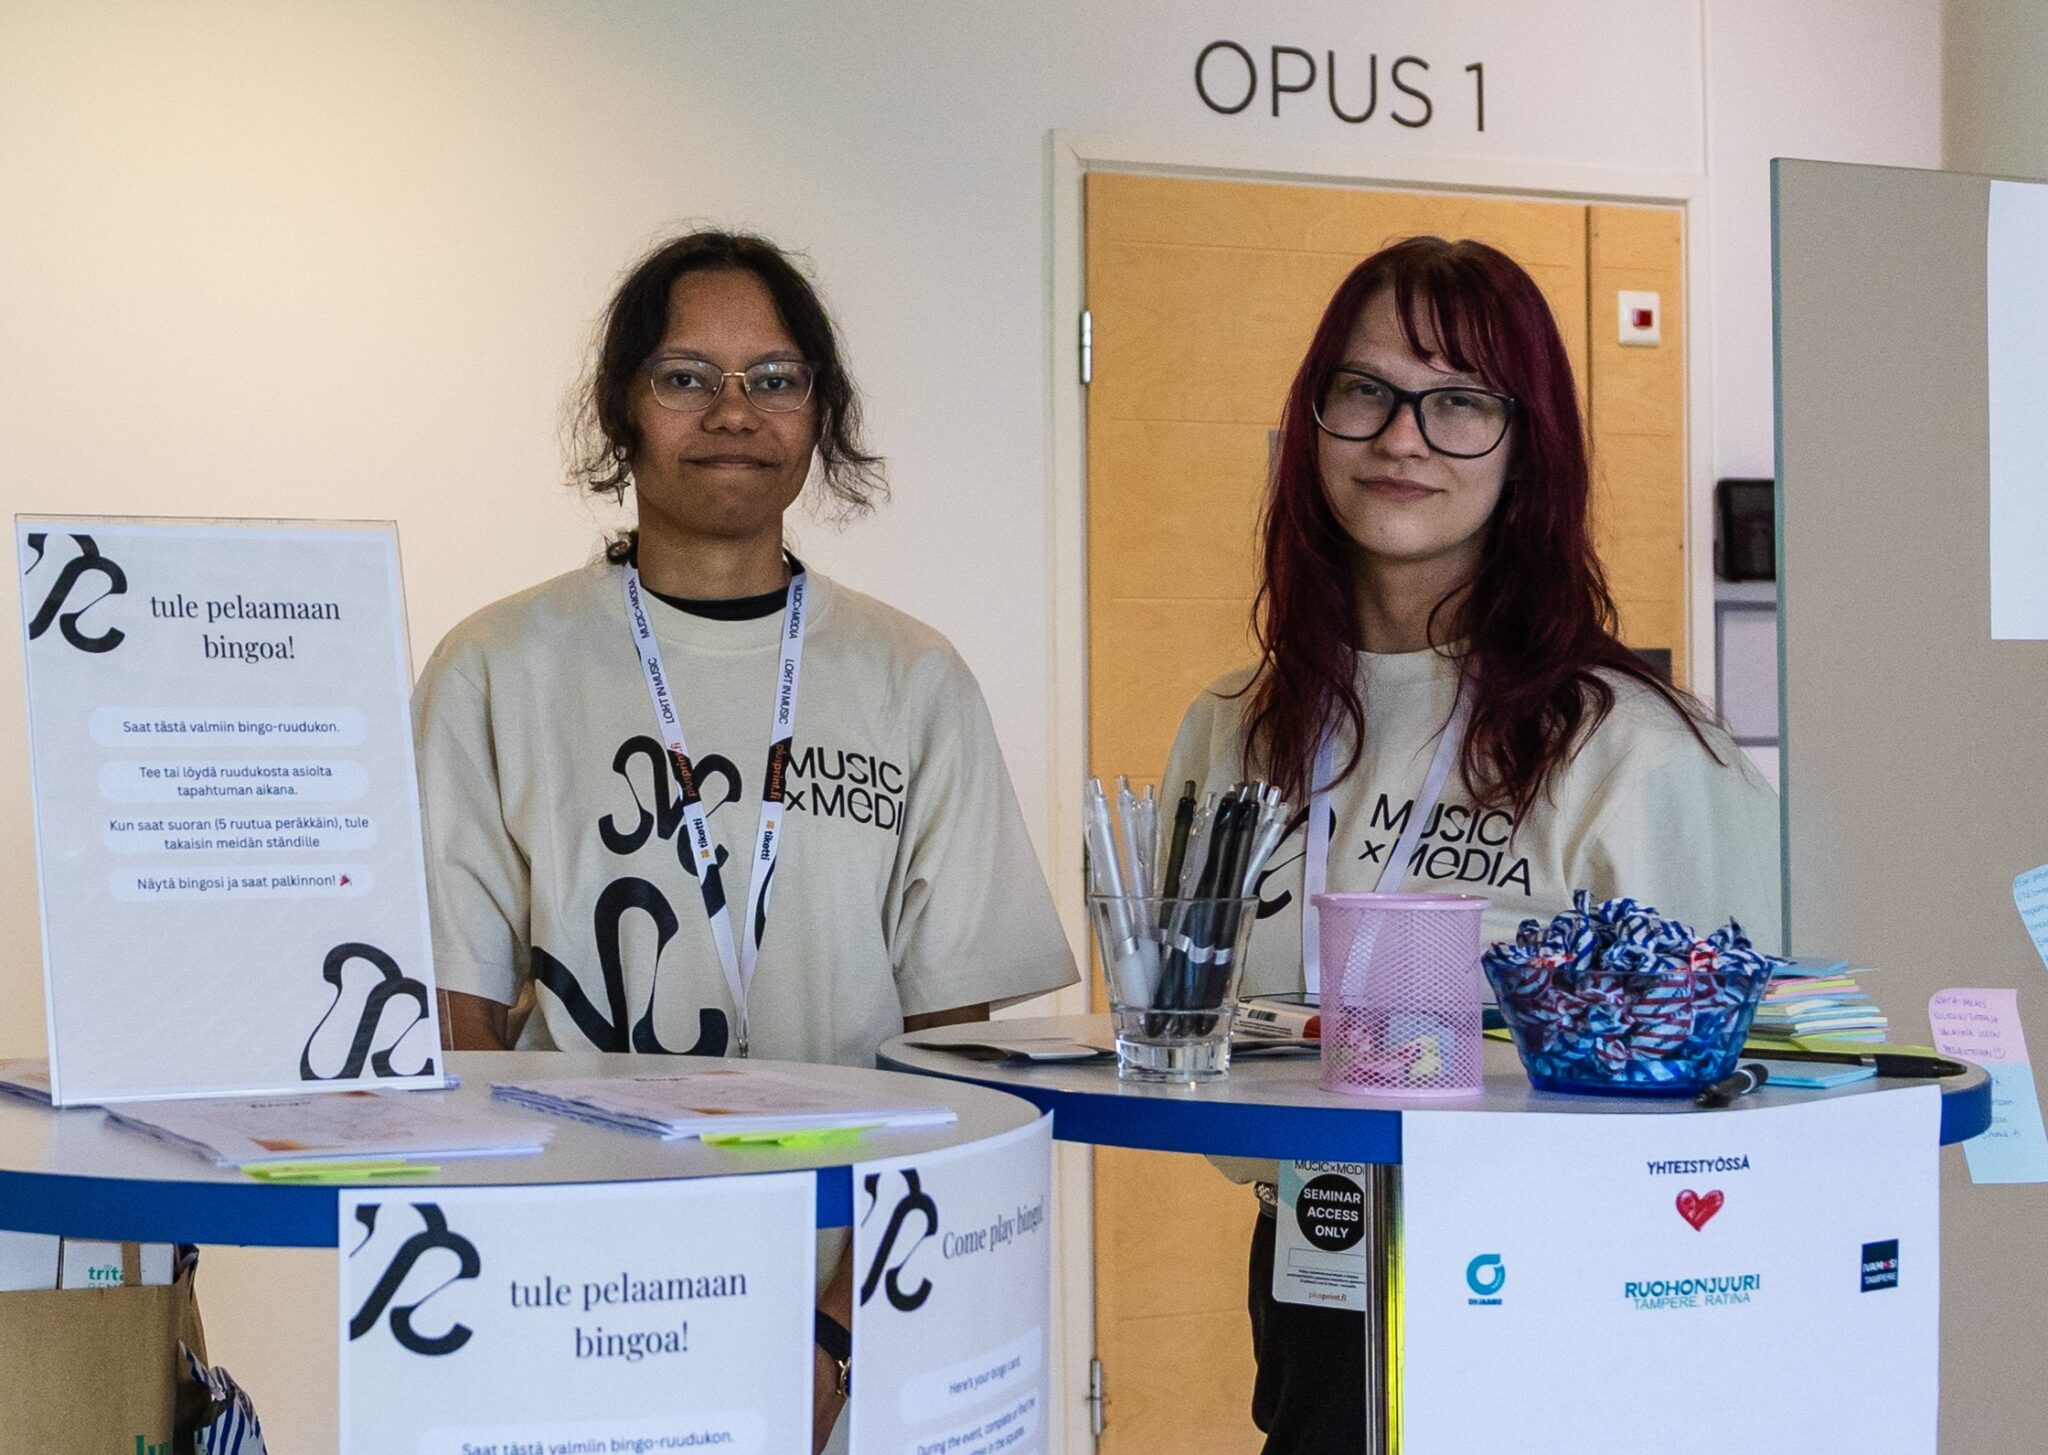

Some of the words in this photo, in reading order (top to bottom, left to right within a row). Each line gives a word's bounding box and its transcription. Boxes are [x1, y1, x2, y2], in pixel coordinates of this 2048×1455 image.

[1195, 39, 1433, 128] OPUS
[1464, 61, 1485, 132] 1
[150, 594, 199, 619] tule
[207, 595, 341, 624] pelaamaan
[203, 634, 296, 664] bingoa!
[778, 695, 791, 725] MUSIC
[123, 721, 152, 734] Saat
[154, 720, 187, 734] tästä
[189, 720, 235, 734] valmiin
[238, 720, 341, 736] bingo-ruudukon.
[139, 766, 161, 778] Tee
[164, 766, 180, 778] tai
[183, 766, 217, 781] löydä
[220, 766, 289, 778] ruudukosta
[292, 765, 332, 777] asioita
[769, 743, 785, 801] plusprint.fi
[787, 747, 904, 795] MUSIC
[177, 784, 253, 799] tapahtuman
[256, 783, 298, 796] aikana.
[110, 820, 134, 832] Kun
[137, 820, 164, 832] saat
[168, 819, 211, 831] suoran
[215, 816, 227, 831] (5
[230, 818, 272, 830] ruutua
[275, 816, 342, 833] peräkkäin),
[345, 816, 369, 828] tule
[1370, 794, 1514, 846] MUSIC
[164, 838, 213, 850] takaisin
[216, 837, 263, 849] meidän
[266, 836, 320, 848] ständille
[137, 877, 176, 893] Näytä
[179, 876, 224, 892] bingosi
[227, 876, 238, 890] ja
[241, 876, 268, 888] saat
[272, 874, 336, 889] palkinnon!
[1646, 1154, 1750, 1175] YHTEISTYÖSSÄ
[1303, 1188, 1361, 1204] SEMINAR
[1307, 1206, 1359, 1222] ACCESS
[943, 1228, 987, 1259] Come
[990, 1213, 1015, 1252] play
[1315, 1225, 1349, 1239] ONLY
[510, 1274, 572, 1308] tule
[583, 1272, 748, 1312] pelaamaan
[1624, 1273, 1760, 1298] RUOHONJUURI
[1705, 1293, 1751, 1307] RATINA
[574, 1321, 690, 1363] bingoa!
[462, 1442, 497, 1455] Saat
[549, 1438, 606, 1455] valmiin
